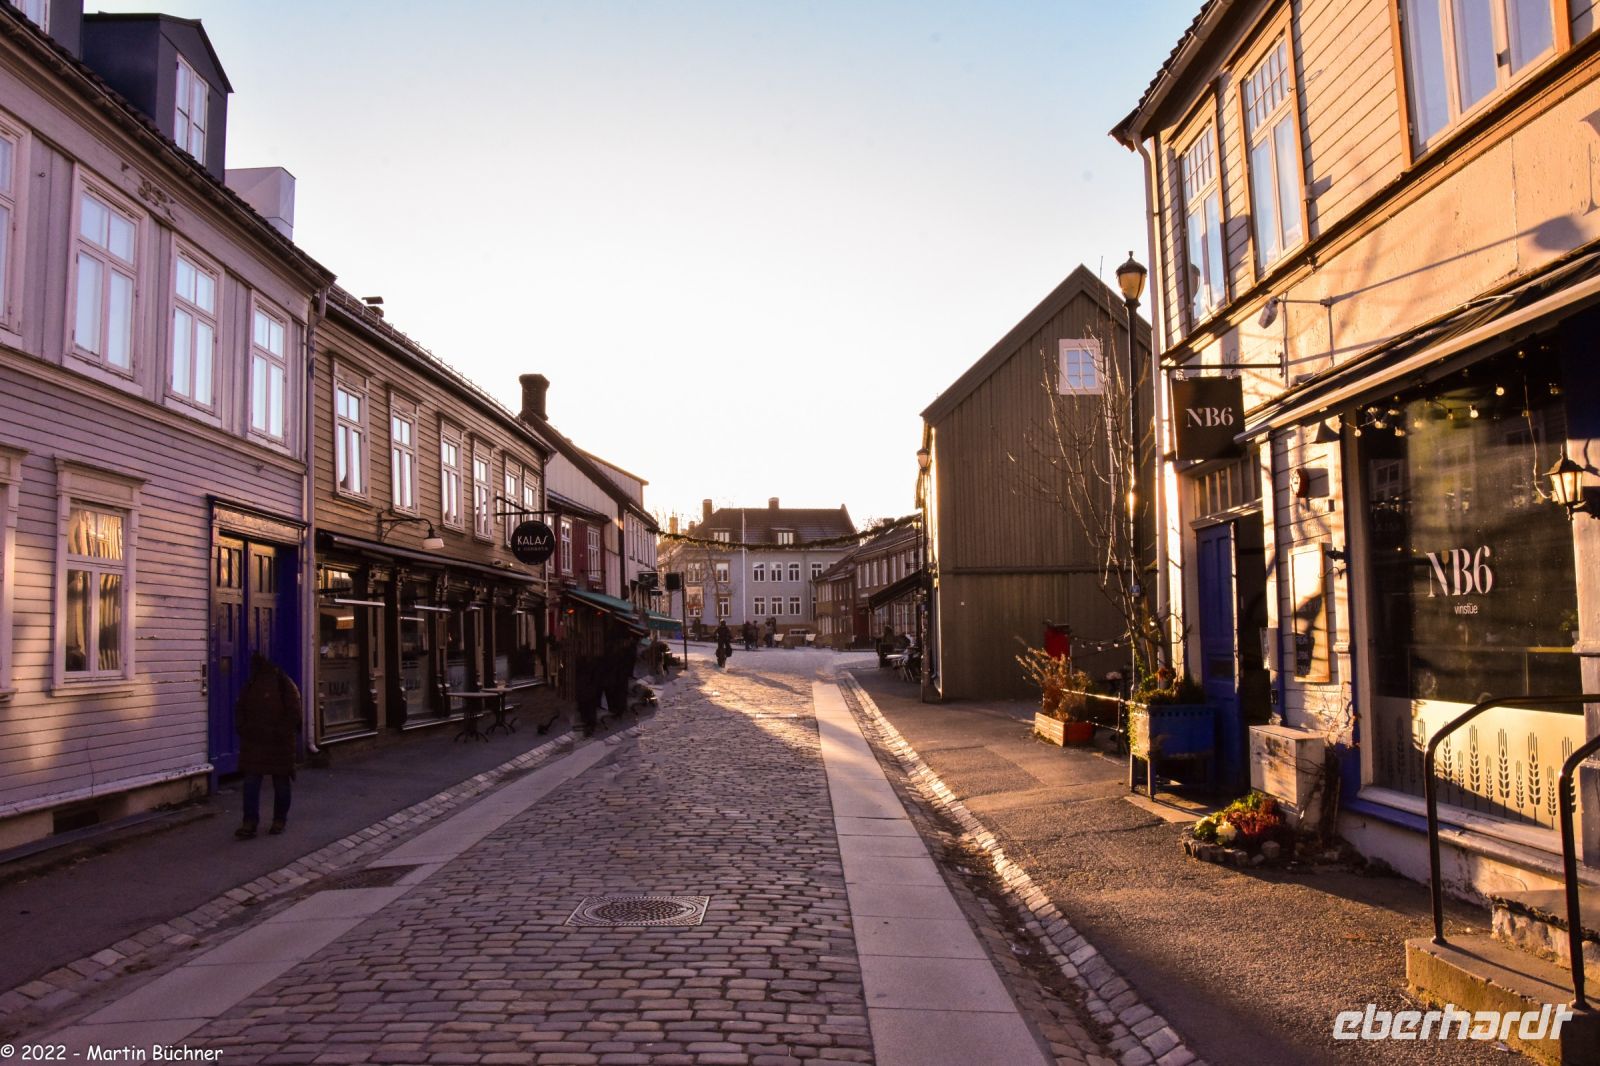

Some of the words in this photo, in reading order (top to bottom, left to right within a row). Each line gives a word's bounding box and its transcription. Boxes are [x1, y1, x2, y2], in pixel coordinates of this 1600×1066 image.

[1186, 407, 1234, 428] NB6
[517, 535, 548, 546] KALAS
[1425, 545, 1493, 598] NB6
